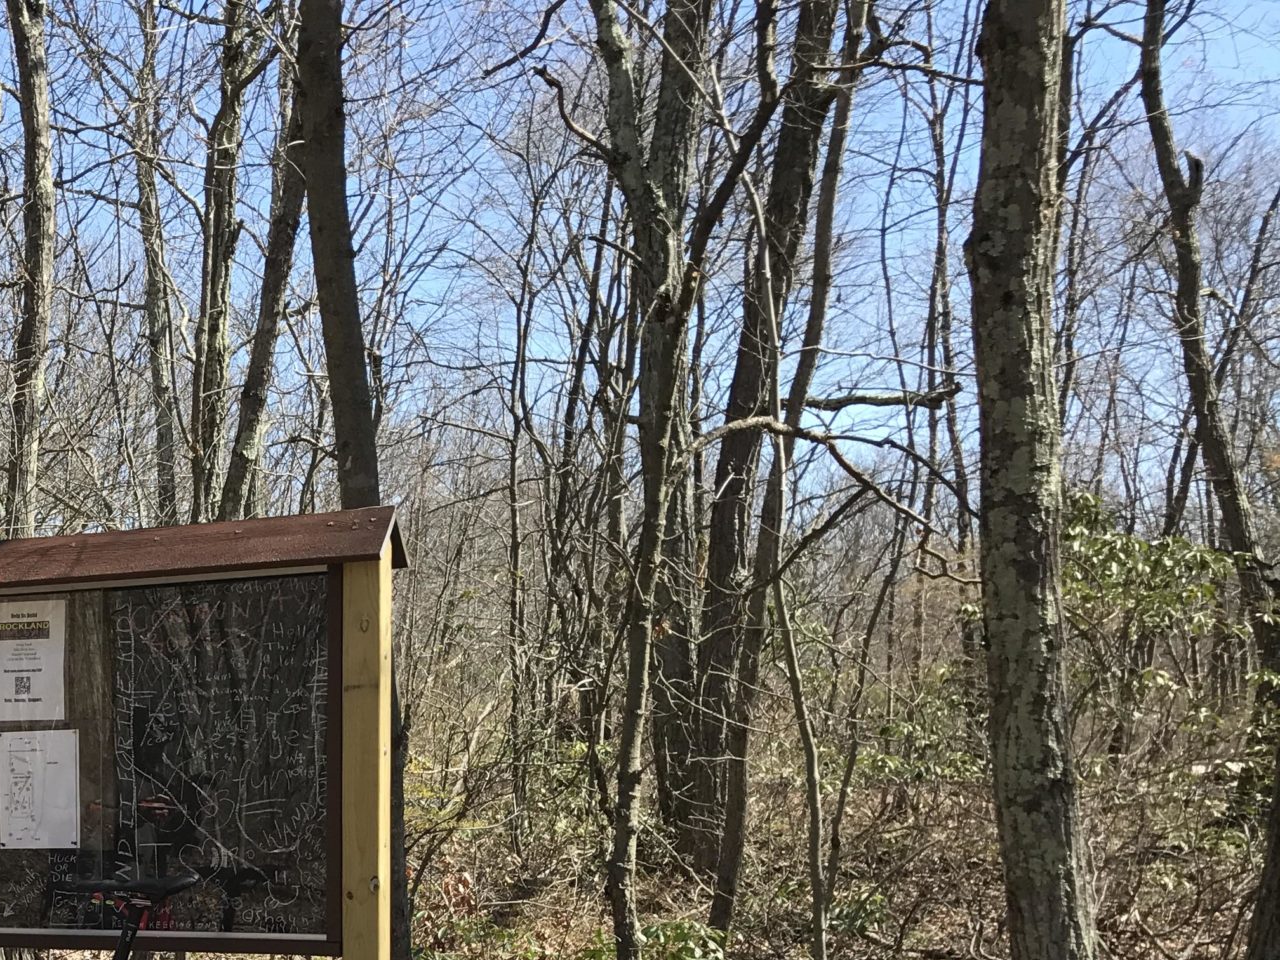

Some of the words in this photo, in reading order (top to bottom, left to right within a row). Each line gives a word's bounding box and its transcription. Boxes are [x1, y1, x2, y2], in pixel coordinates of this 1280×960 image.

[0, 622, 49, 631] ROCKLAND
[48, 852, 77, 864] HUCK
[54, 864, 69, 872] OR
[50, 871, 73, 882] DIE
